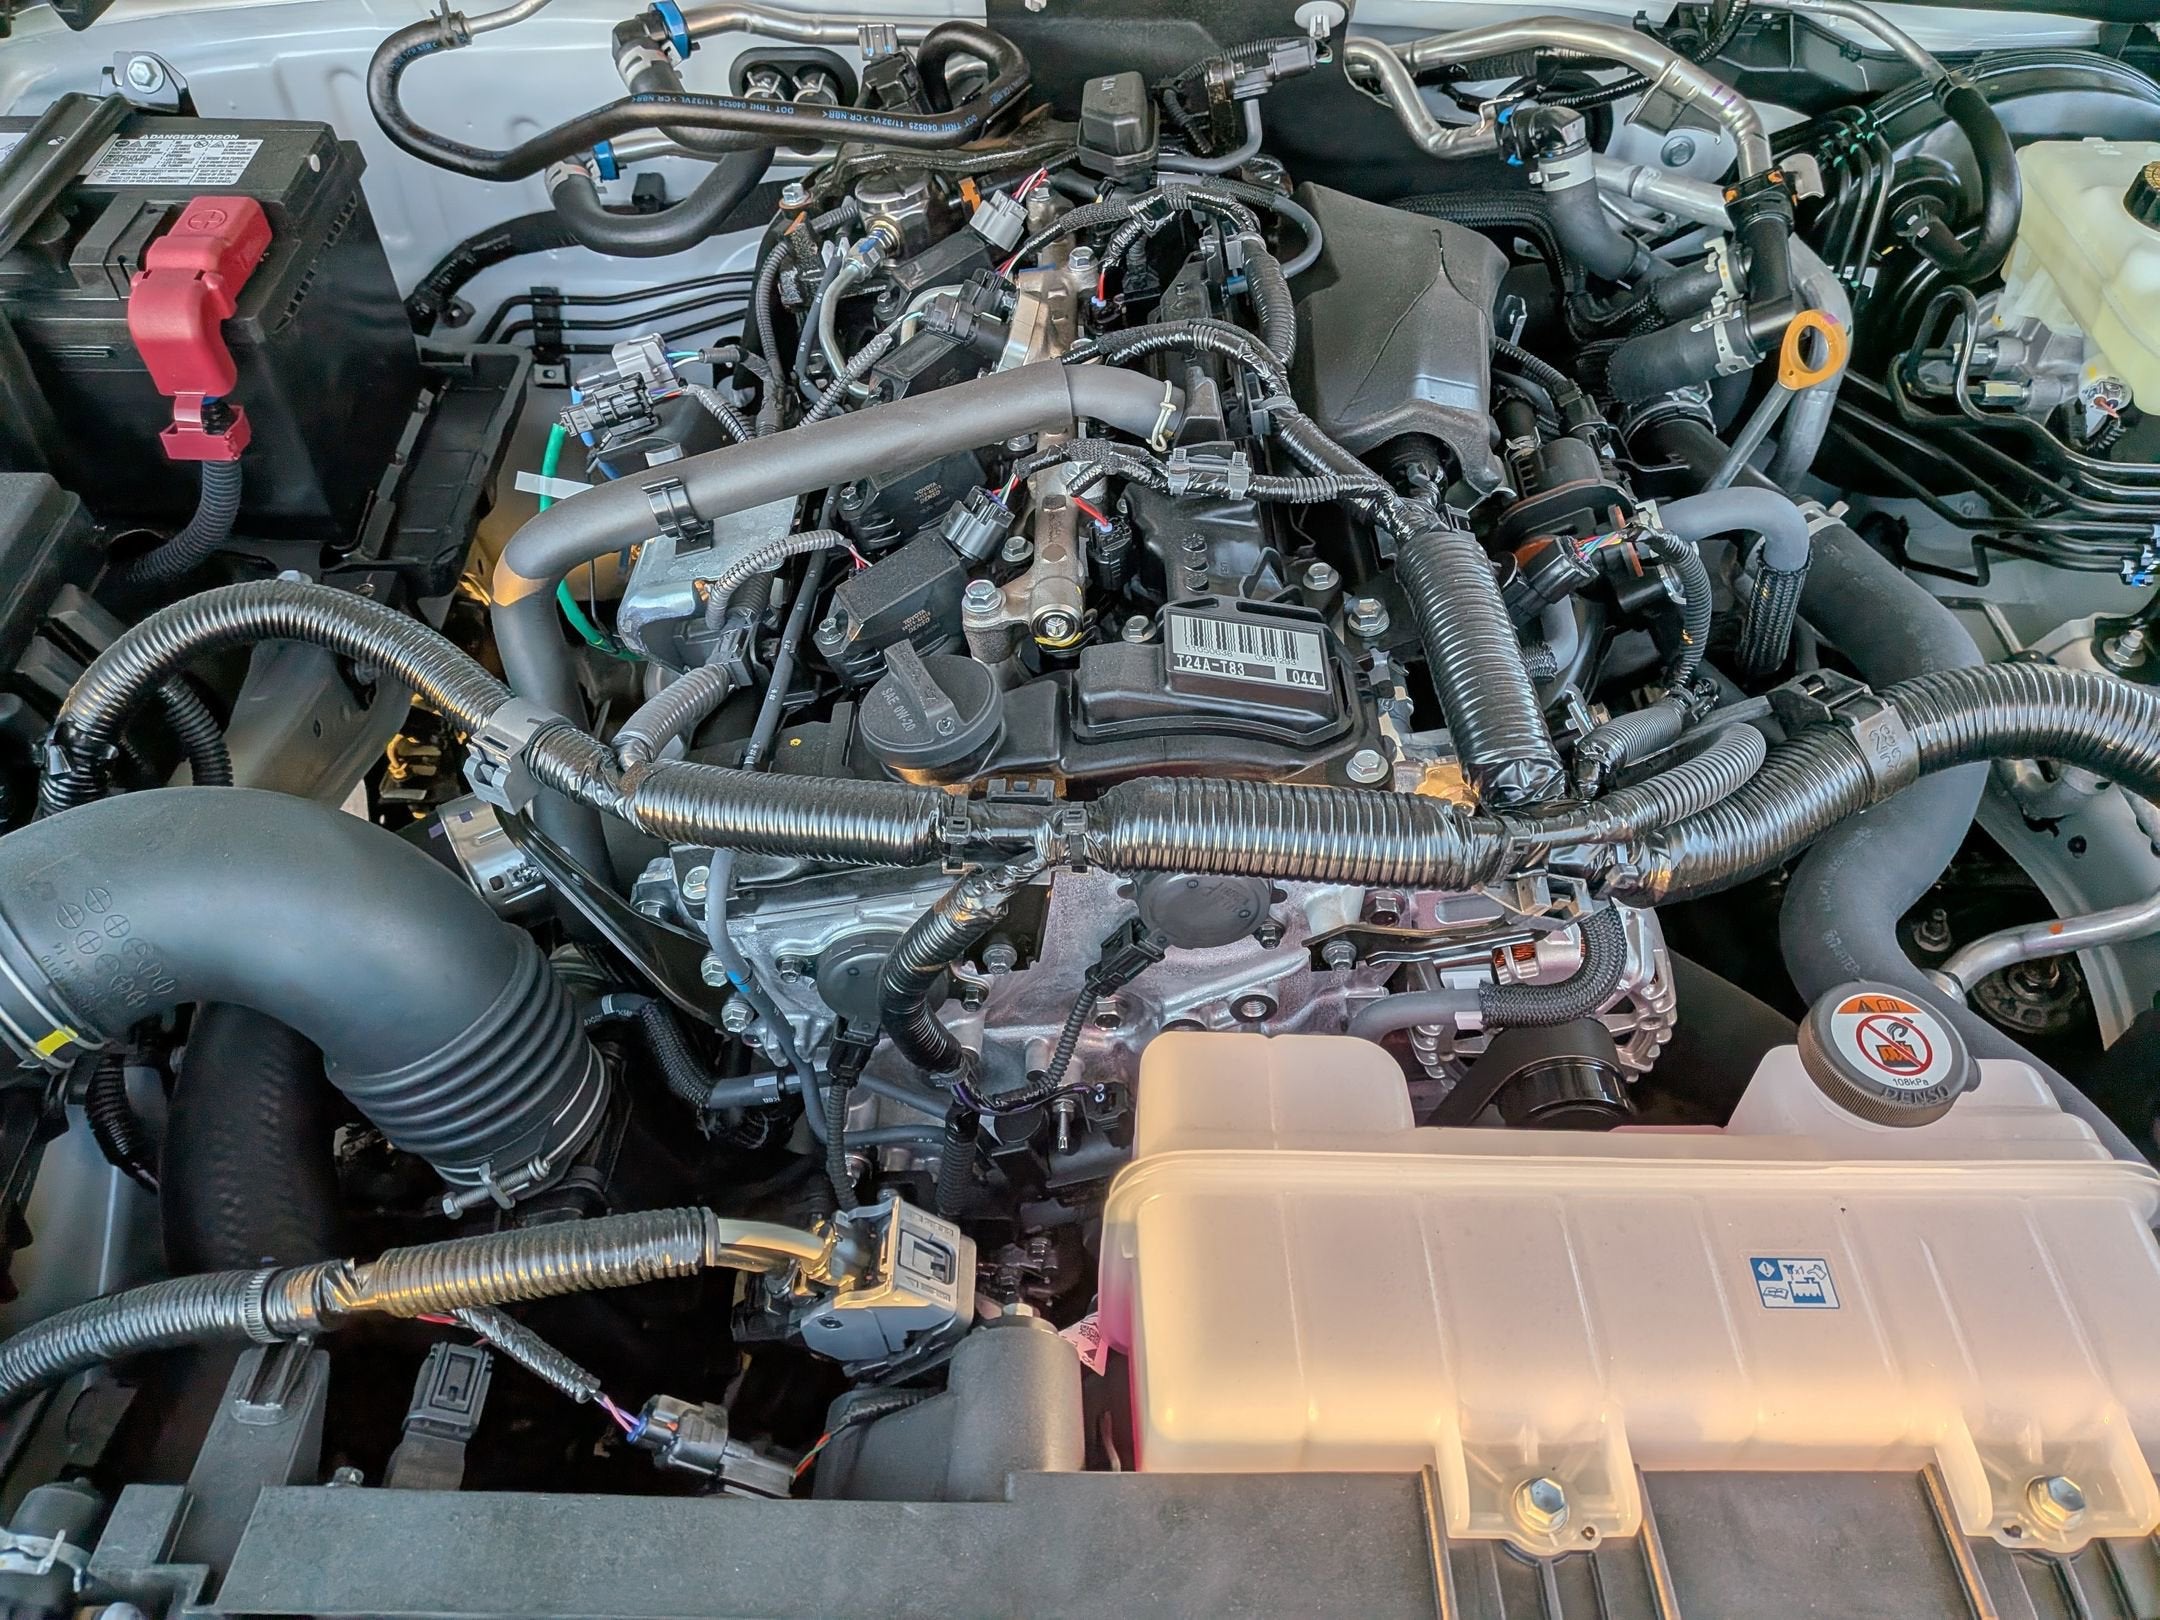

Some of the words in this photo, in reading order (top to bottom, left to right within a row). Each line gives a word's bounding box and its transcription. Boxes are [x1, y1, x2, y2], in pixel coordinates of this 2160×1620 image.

[718, 100, 747, 110] 040525
[774, 106, 795, 115] DOT
[908, 121, 938, 132] 040525
[902, 609, 926, 625] TOYOTA
[1176, 654, 1246, 676] T24A-T83
[1292, 669, 1318, 686] 044
[881, 687, 900, 706] SAE
[1892, 1077, 1930, 1087] 108kPa
[1881, 1085, 1950, 1105] DENSO
